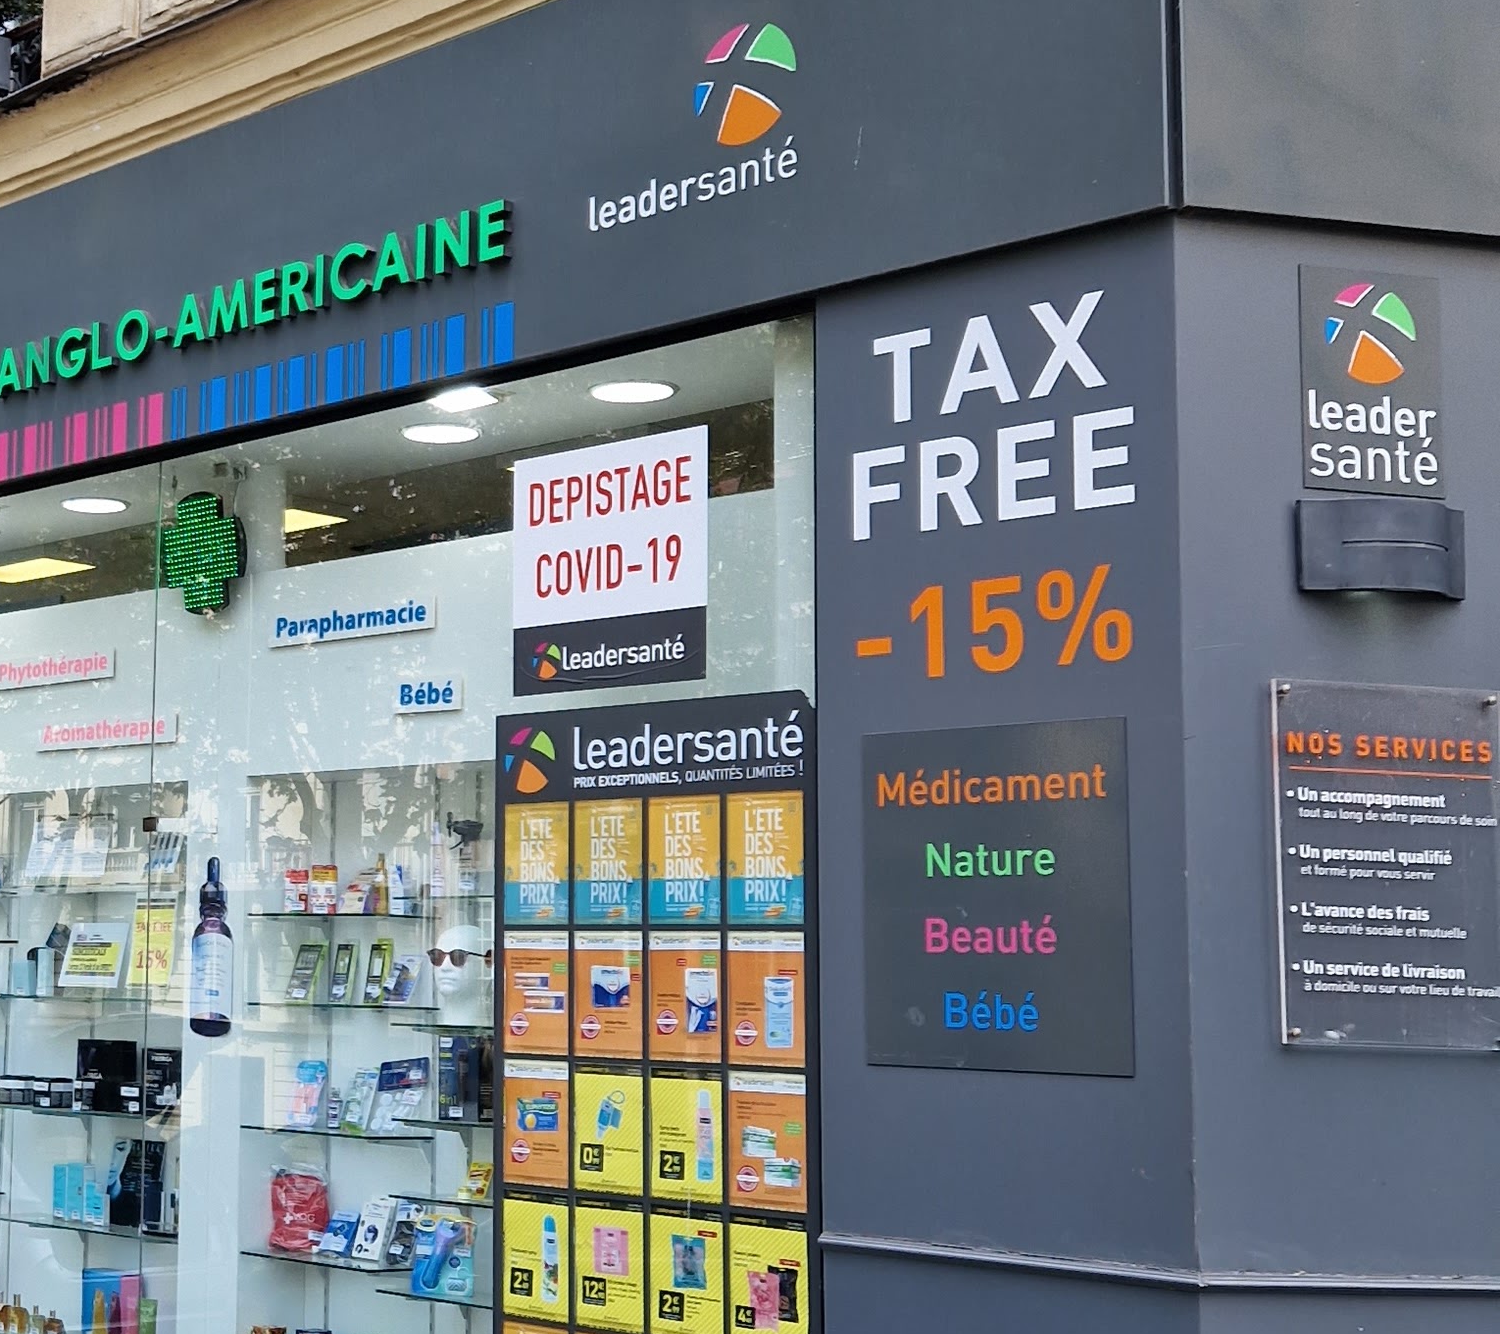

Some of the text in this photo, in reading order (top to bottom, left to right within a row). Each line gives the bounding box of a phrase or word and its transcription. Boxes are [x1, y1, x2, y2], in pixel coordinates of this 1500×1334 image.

[588, 134, 799, 234] leadersanté
[872, 289, 1109, 425] TAX
[1307, 388, 1438, 443] leader
[850, 405, 1138, 542] FREE
[1308, 435, 1439, 487] santé
[529, 454, 693, 527] DEPISTAGE
[535, 534, 683, 599] COVID-19
[275, 599, 428, 640] Parapharmacie
[855, 562, 1136, 680] -15%
[400, 680, 454, 706] Bébé
[43, 715, 166, 745] Aromathérapie
[1286, 729, 1494, 764] NOS SERVICES
[573, 775, 597, 789] PRIX
[598, 771, 683, 788] EXCEPTIONNELS,
[684, 766, 743, 783] QUANTITÉS
[745, 762, 796, 780] LIMITÉES
[876, 762, 1108, 810] Médicament
[1297, 786, 1446, 809] Un accompagnement
[1297, 806, 1498, 827] tout au long de votre parcours de soin
[520, 841, 545, 861] DES
[590, 837, 617, 859] DES
[665, 835, 692, 857] DES
[745, 831, 773, 855] DES
[1299, 844, 1453, 866] Un personnel qualifié
[520, 862, 556, 882] BONS
[590, 859, 628, 882] BONS
[665, 857, 704, 879] BONS
[745, 856, 786, 879] BONS
[924, 842, 1057, 878] Nature
[1300, 865, 1313, 876] et
[1313, 864, 1347, 877] formé
[1348, 869, 1375, 880] pour
[1403, 869, 1436, 881] servir
[1300, 901, 1431, 922] L'avance des frais
[924, 913, 1058, 955] Beauté
[1302, 921, 1468, 939] de sécurité sociale et mutuelle
[1302, 959, 1467, 980] Un service de livraison
[1313, 979, 1361, 993] domicile
[1362, 983, 1378, 994] ou
[1378, 984, 1397, 994] sur
[1399, 984, 1428, 996] votre
[1428, 984, 1450, 996] lieu
[1451, 985, 1467, 997] de
[943, 989, 1040, 1032] Bébé
